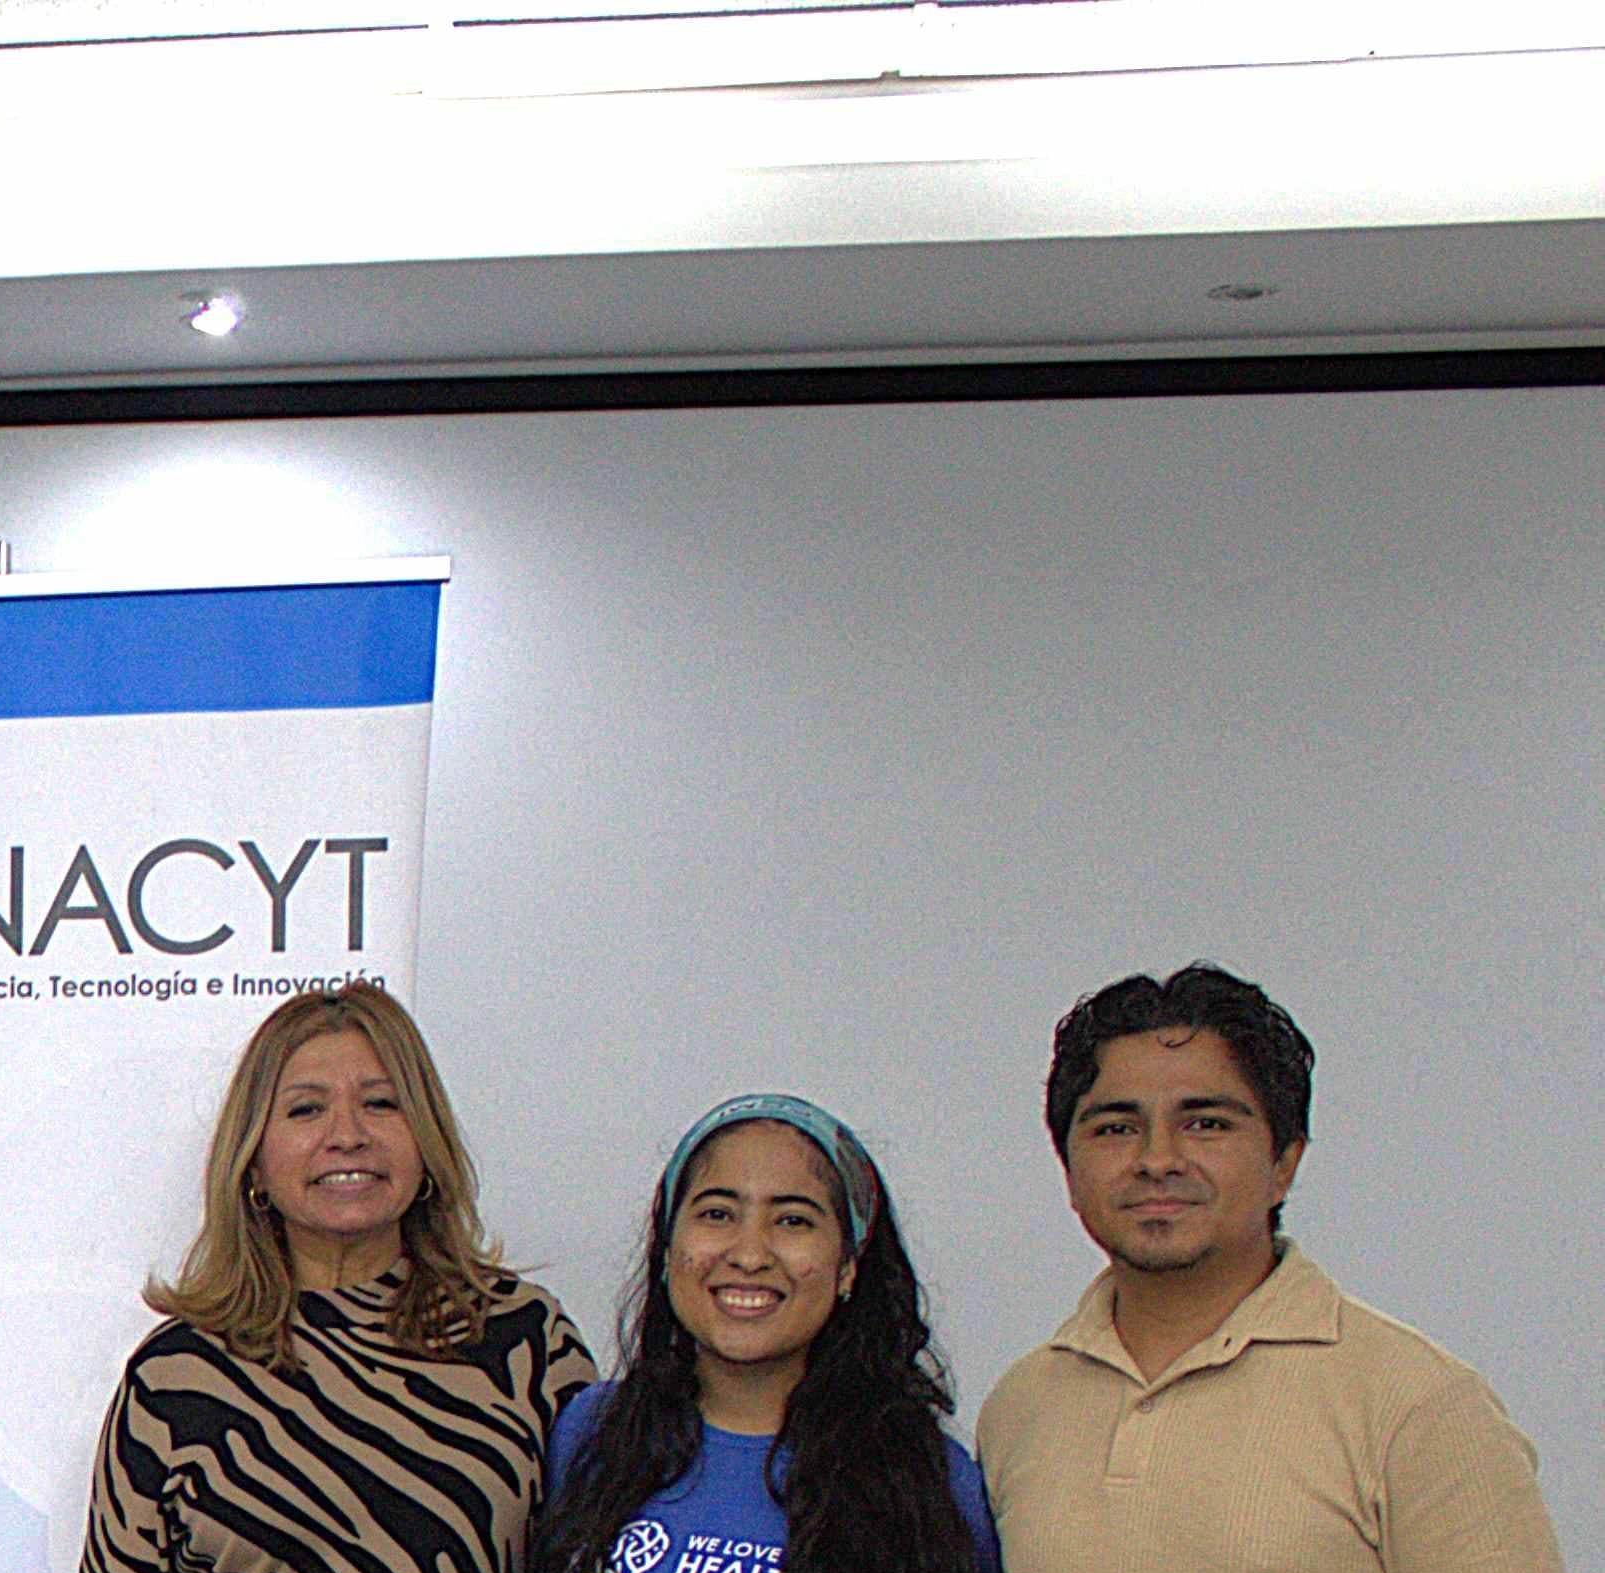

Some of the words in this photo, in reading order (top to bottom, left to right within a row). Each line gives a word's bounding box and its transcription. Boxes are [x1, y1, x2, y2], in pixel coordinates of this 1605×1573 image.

[49, 971, 197, 1001] Tecnología
[206, 979, 224, 996] e
[688, 1535, 721, 1552] WE
[722, 1540, 783, 1563] LOVE
